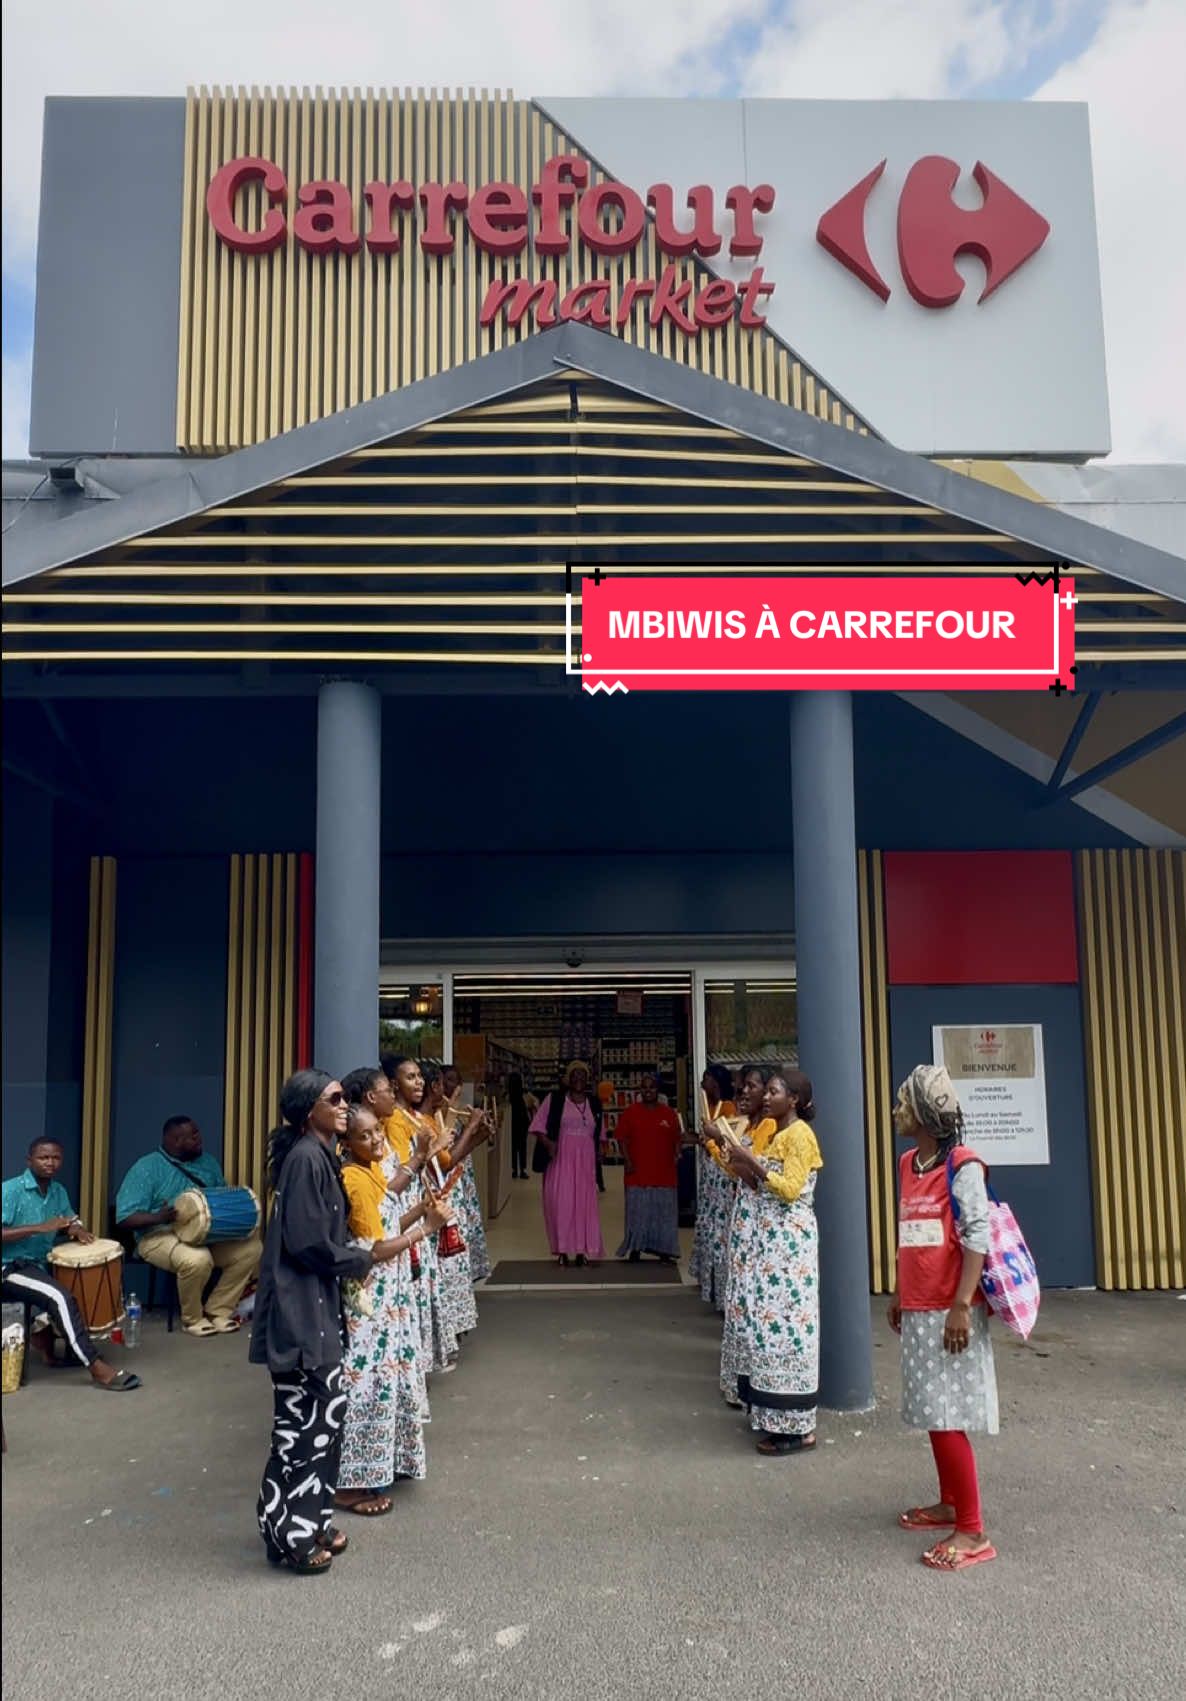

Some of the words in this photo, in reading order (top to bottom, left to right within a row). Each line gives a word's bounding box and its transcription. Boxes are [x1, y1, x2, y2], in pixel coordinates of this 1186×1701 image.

[206, 154, 775, 256] Carrefour
[480, 263, 775, 334] market
[962, 1063, 1017, 1072] BIENVENUE
